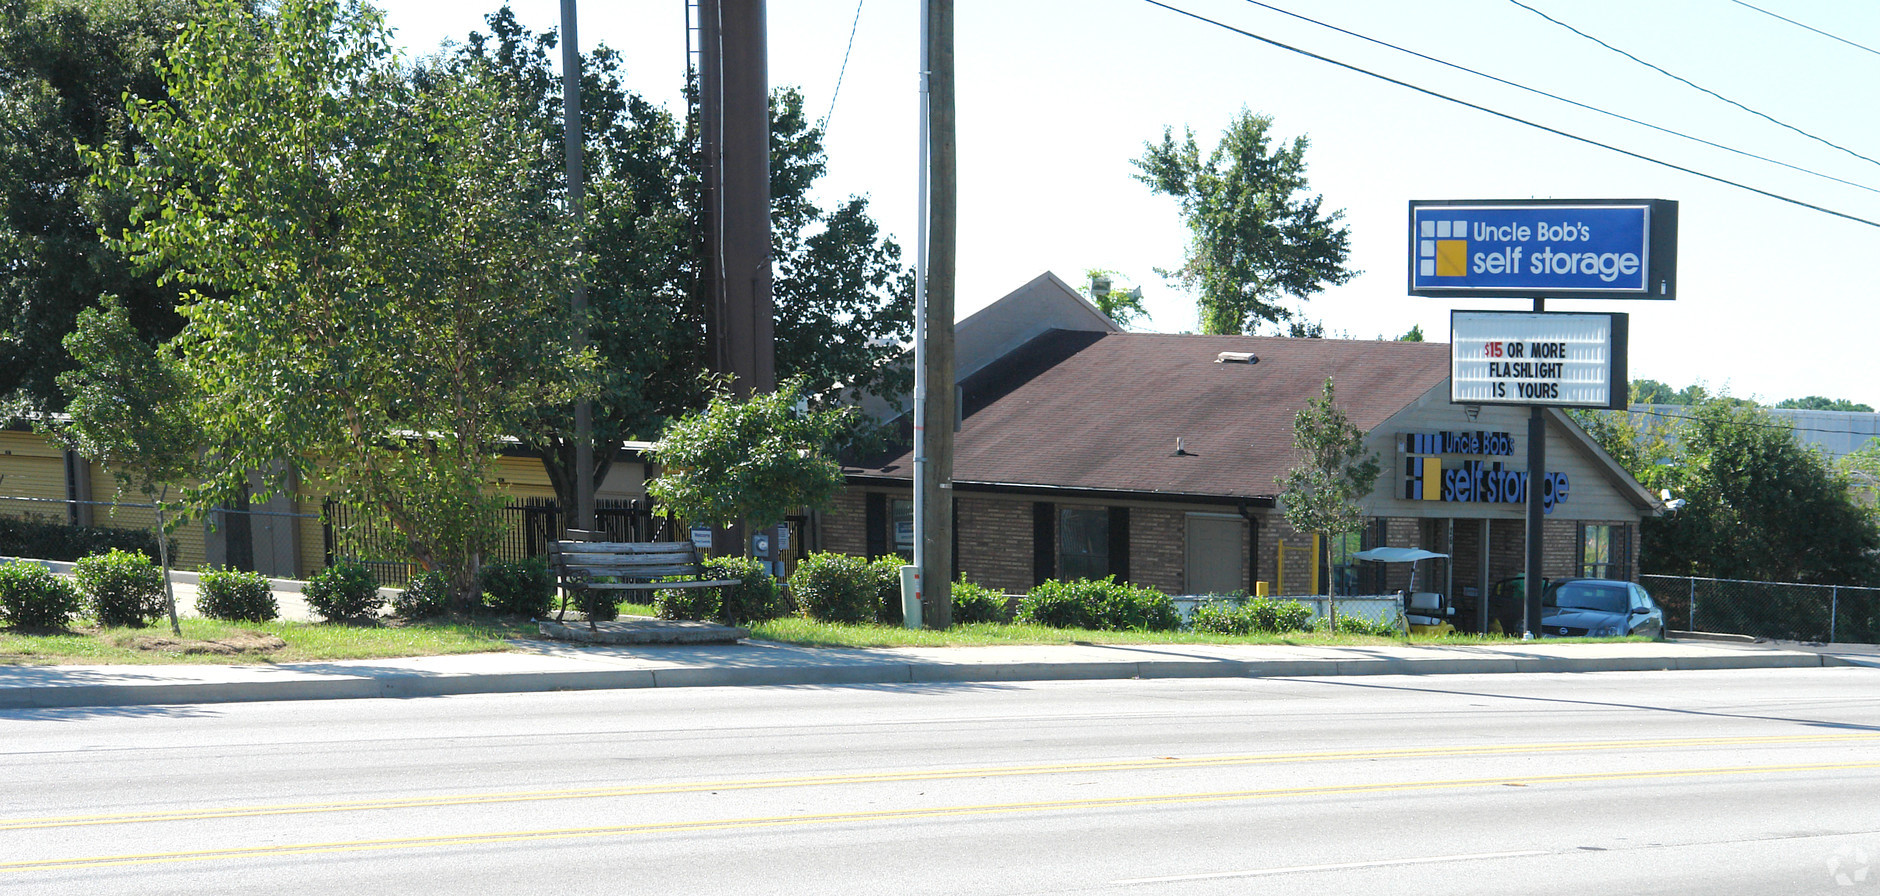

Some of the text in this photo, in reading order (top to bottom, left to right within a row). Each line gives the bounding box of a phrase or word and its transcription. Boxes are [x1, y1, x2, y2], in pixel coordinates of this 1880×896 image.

[1473, 221, 1590, 242] Uncle Bob's
[1473, 246, 1640, 282] self storage
[1484, 341, 1566, 359] $15 OR MORE
[1489, 361, 1563, 379] FLASHLIGHT
[1492, 382, 1559, 399] IS YOURS
[1446, 431, 1480, 454] Uncle
[1445, 460, 1570, 515] self storge
